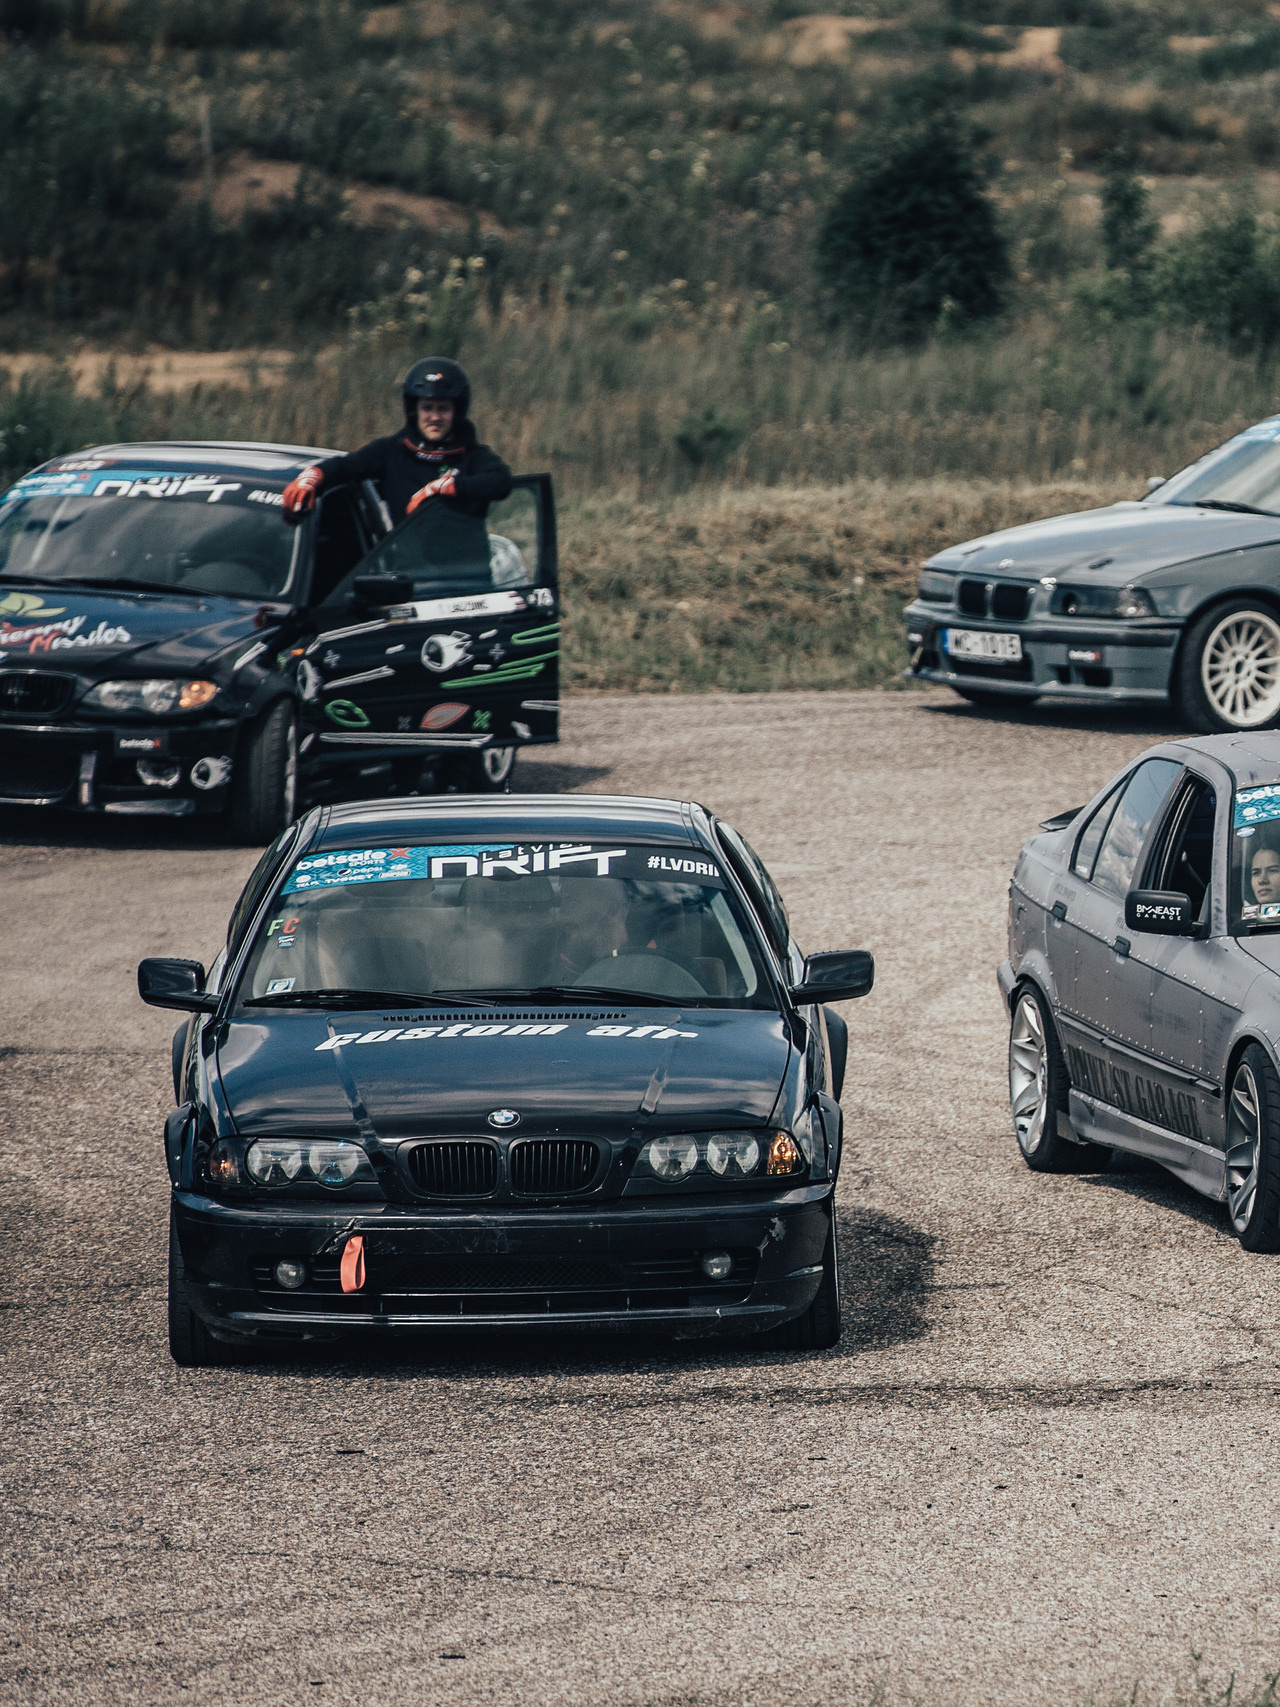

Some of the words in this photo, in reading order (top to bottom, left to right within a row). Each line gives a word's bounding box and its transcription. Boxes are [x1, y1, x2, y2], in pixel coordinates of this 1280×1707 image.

[296, 849, 388, 871] betsafe
[431, 845, 627, 879] DRIFT
[1136, 912, 1182, 921] GARAGE
[314, 1023, 569, 1051] custom
[586, 1024, 699, 1040] afr
